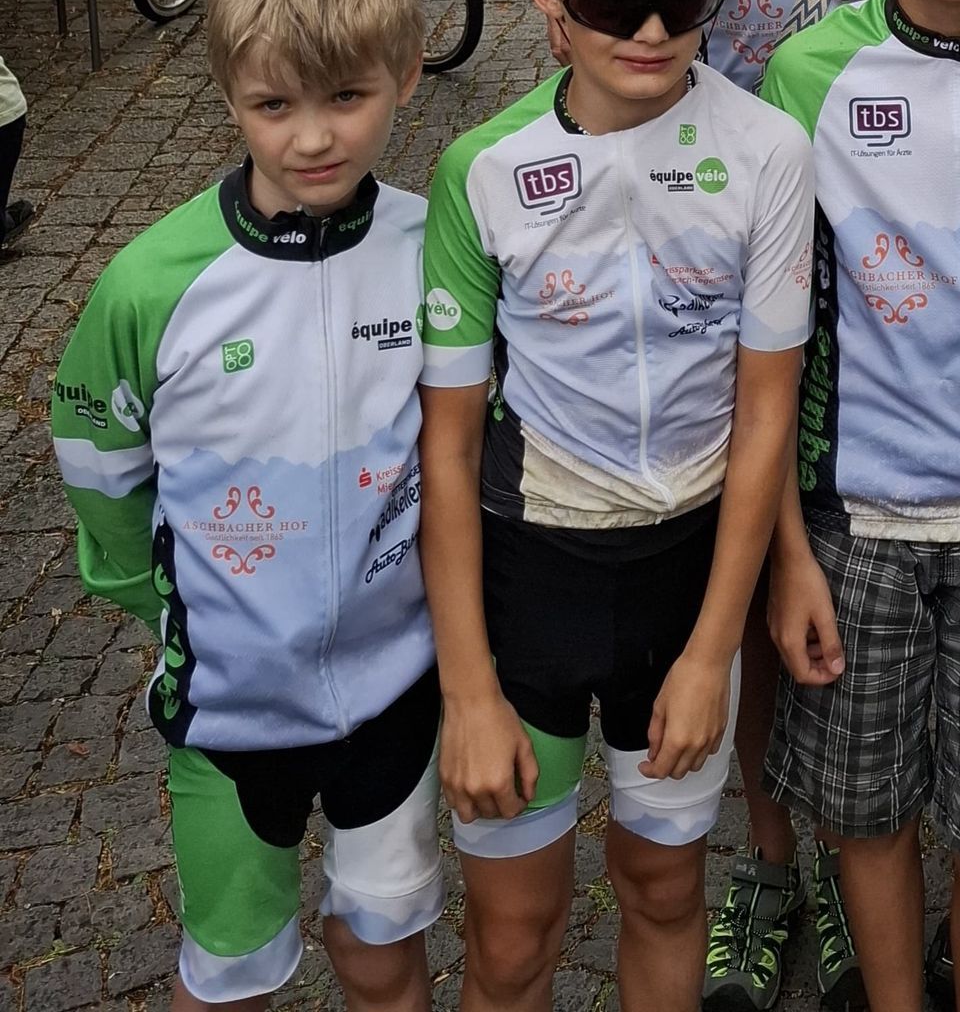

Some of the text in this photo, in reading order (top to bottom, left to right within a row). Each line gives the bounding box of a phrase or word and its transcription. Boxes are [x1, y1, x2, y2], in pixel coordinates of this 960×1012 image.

[860, 103, 900, 127] tbs
[851, 150, 885, 158] IT-Lösungen
[896, 148, 912, 156] Ärzte
[527, 167, 571, 195] tbs
[649, 169, 727, 184] équipe vélo
[273, 231, 307, 244] vélo
[918, 282, 936, 290] 1865
[931, 274, 957, 285] HOF
[427, 301, 458, 317] vélo
[351, 318, 412, 341] équipe
[379, 339, 411, 349] OBERLAND
[183, 520, 309, 533] ASCHBACHER HOF
